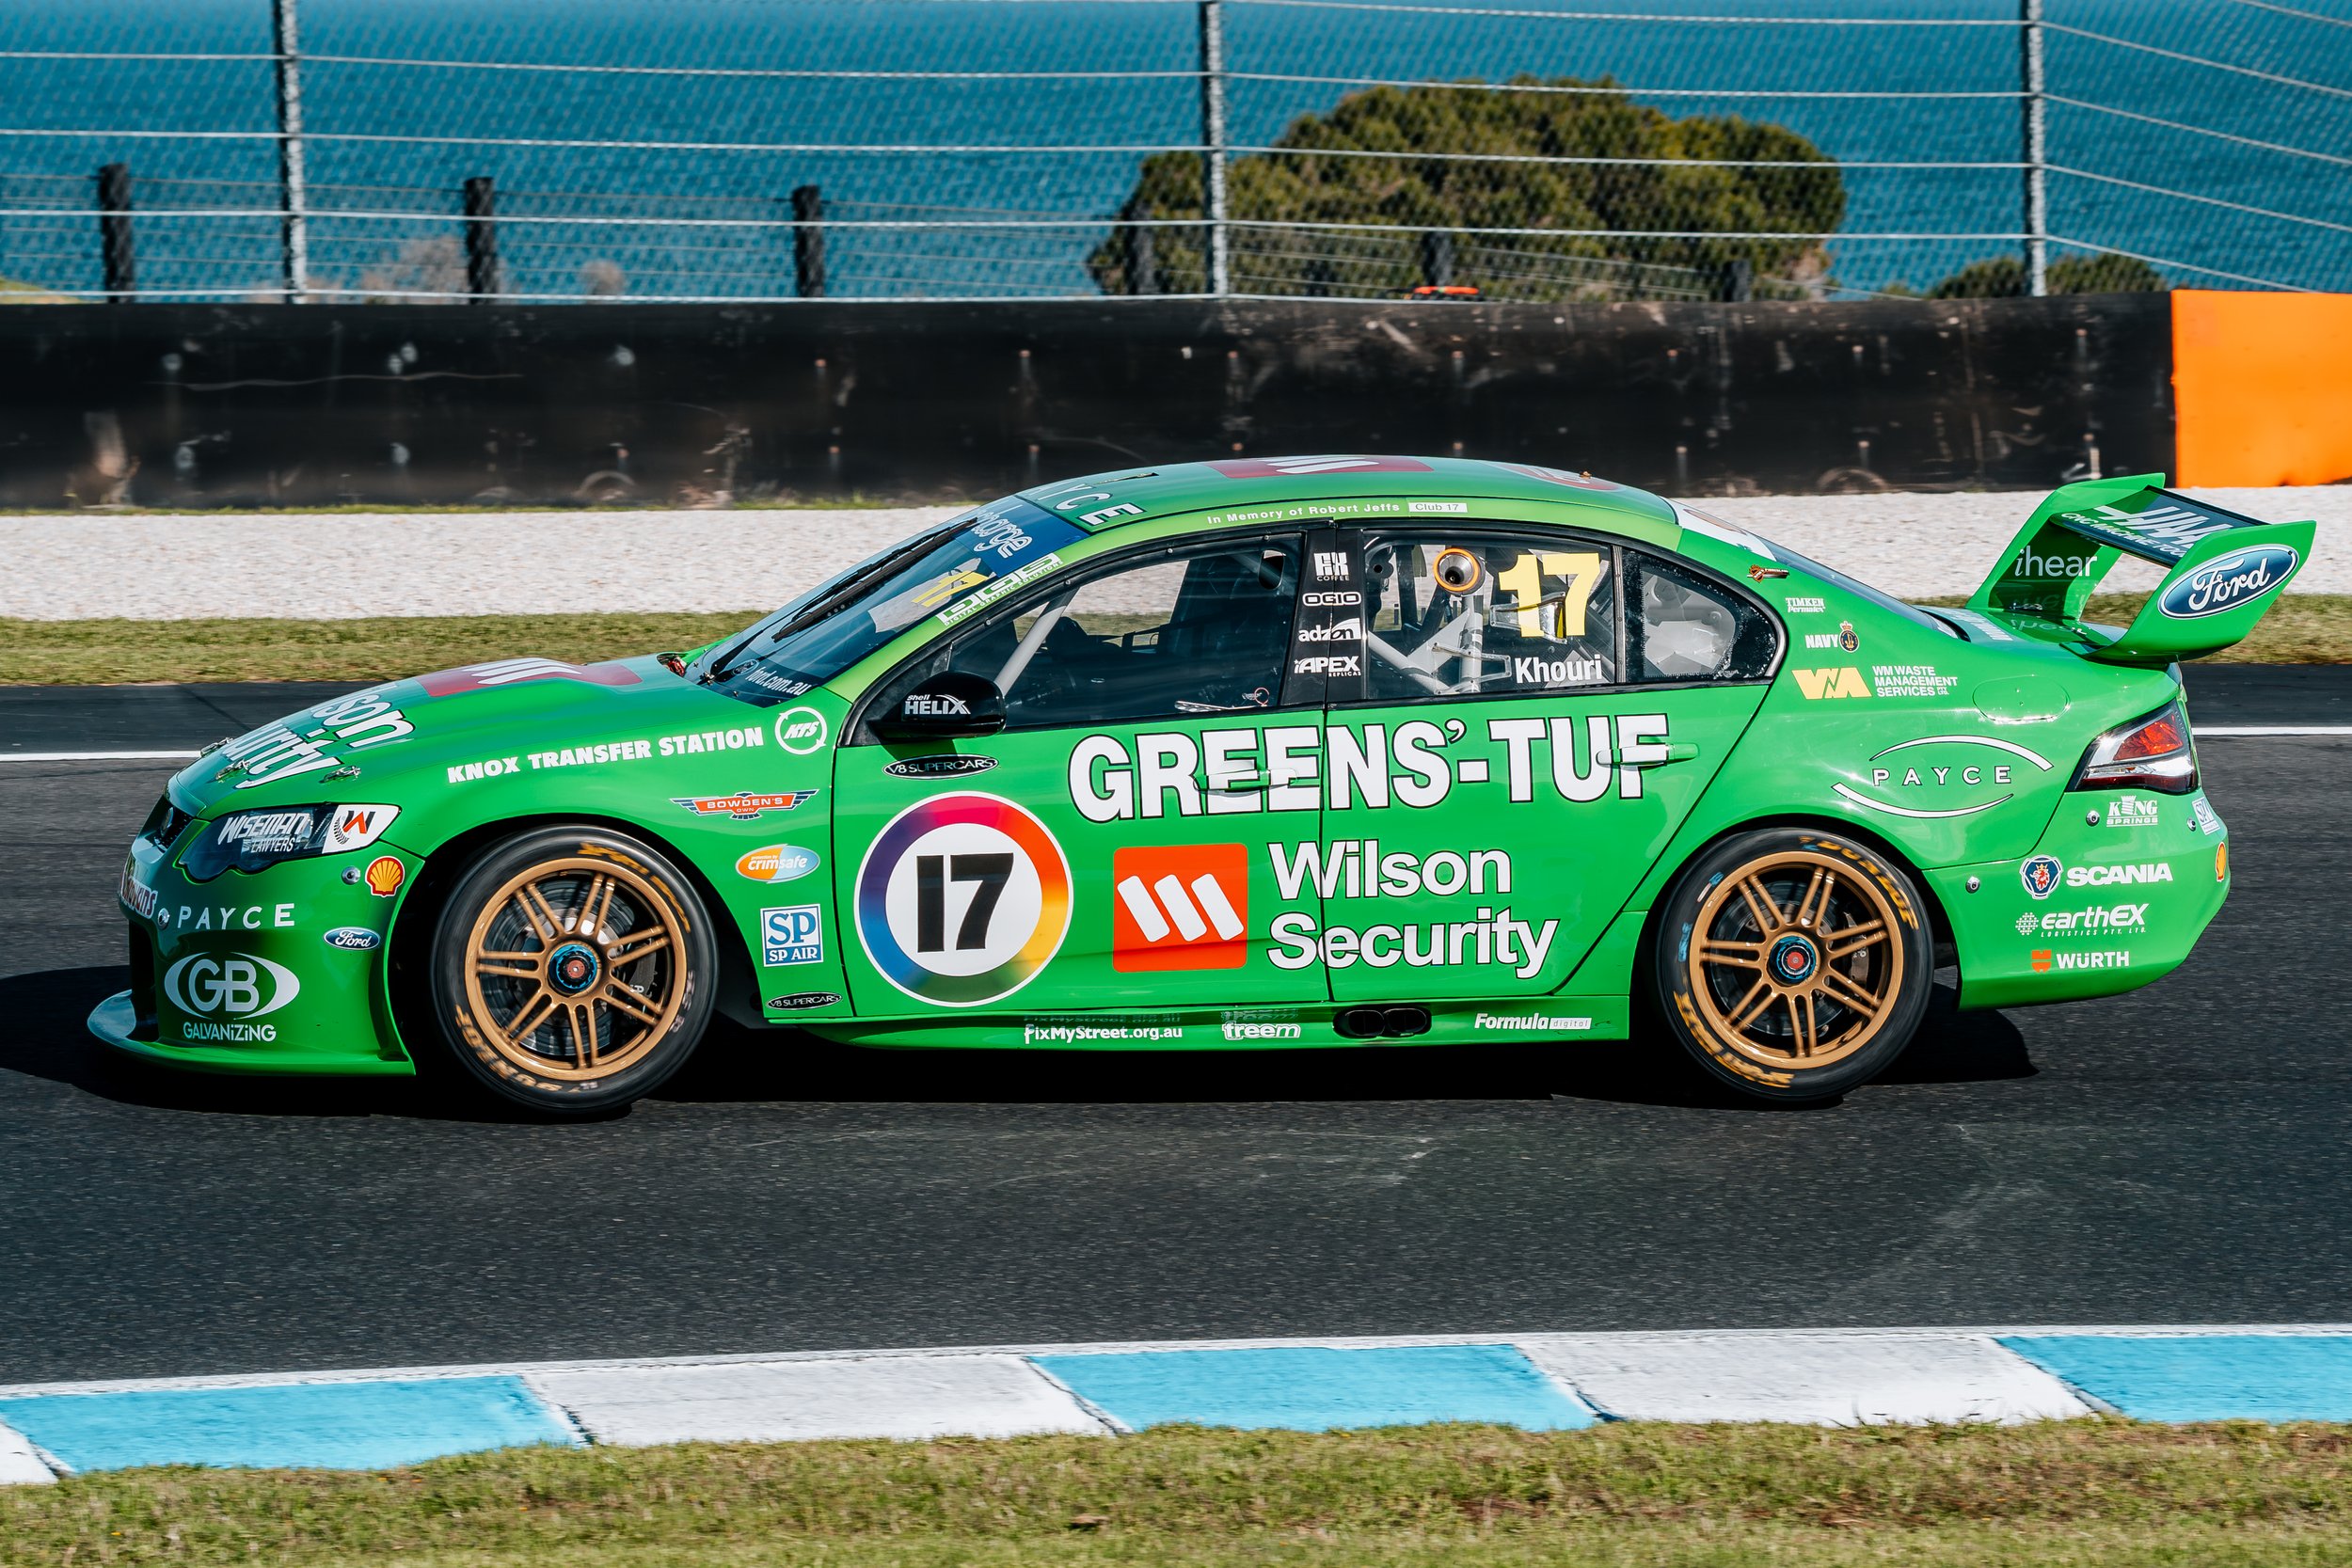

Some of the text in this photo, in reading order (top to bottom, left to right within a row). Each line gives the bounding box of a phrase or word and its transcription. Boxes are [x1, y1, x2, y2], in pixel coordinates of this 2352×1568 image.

[1037, 483, 1145, 526] YCE
[1208, 503, 1400, 524] In Memory of Robert Jeffs
[1415, 503, 1459, 512] Club 17
[2090, 522, 2160, 546] MACHINE
[2014, 546, 2098, 577] ihear
[944, 560, 1065, 626] DIGITAL GRAPHIC SOLUTIONS
[1303, 593, 1360, 605] OGIO
[1498, 552, 1601, 638] 17
[1786, 597, 1824, 607] TIMKEN
[1804, 634, 1839, 648] NAVY
[1515, 654, 1603, 684] Khouri
[1872, 665, 1936, 676] WM WASTE
[1874, 676, 1958, 688] MANAGEMENT
[1876, 687, 1935, 697] SERVICES
[905, 699, 971, 715] HELIX
[447, 727, 764, 784] KNOX TRANSFER STATION
[887, 758, 994, 773] V8 SUPERCARS
[1872, 765, 2012, 787] PAYCE
[707, 797, 784, 809] BOWDEN'S
[217, 813, 310, 845] WISEMAN
[2107, 816, 2158, 825] SPRINGS
[250, 837, 295, 853] LAWYERS
[748, 855, 808, 871] crimsafe
[1266, 839, 1513, 900] Wilson
[2066, 863, 2173, 887] SCANIA
[916, 852, 1014, 953] 17
[177, 903, 295, 930] PAYCE
[2041, 903, 2150, 929] earthEX
[768, 911, 817, 946] SP
[2041, 928, 2098, 938] LOGISTICS
[1266, 906, 1561, 979] Security
[769, 947, 818, 962] SP AIR
[188, 958, 260, 1012] GB
[783, 994, 839, 1006] SUPERCARS
[1222, 1022, 1301, 1040] freem
[1474, 1013, 1588, 1030] Formula digital
[1024, 1023, 1183, 1044] FixMyStreet.org.au
